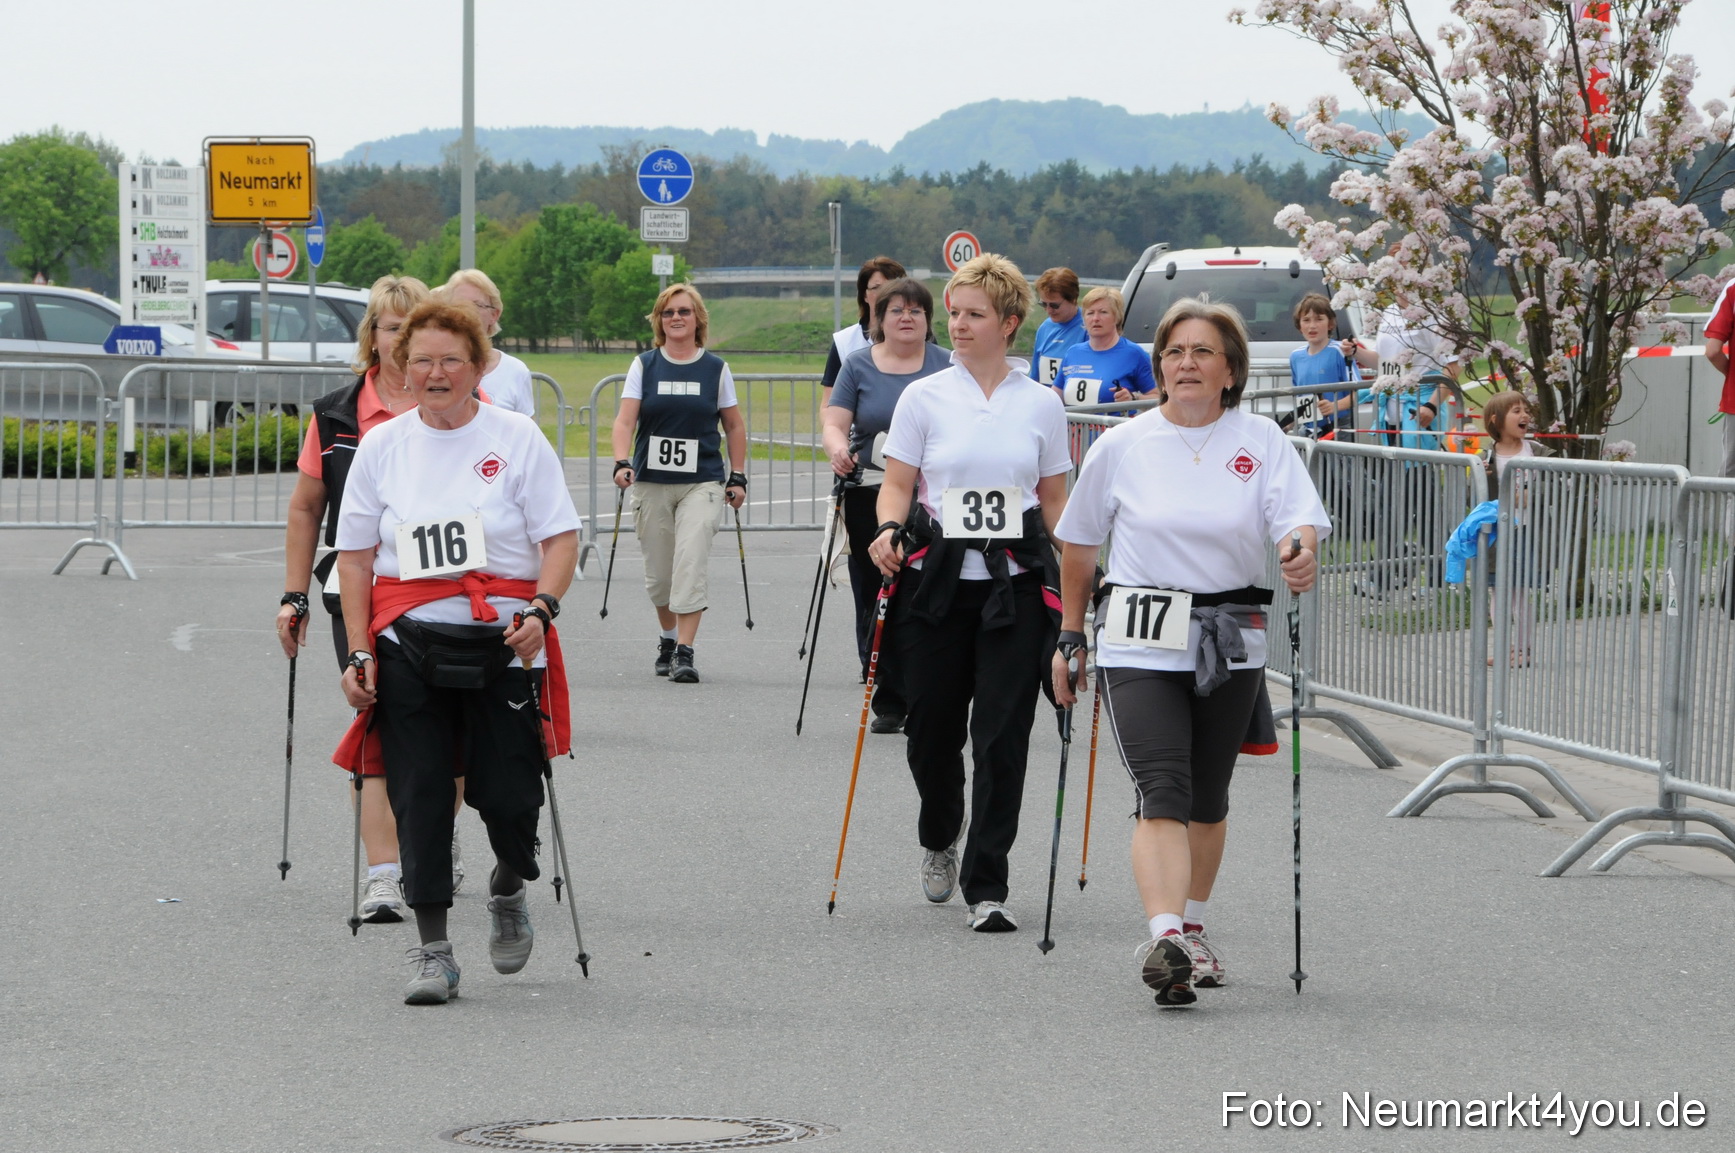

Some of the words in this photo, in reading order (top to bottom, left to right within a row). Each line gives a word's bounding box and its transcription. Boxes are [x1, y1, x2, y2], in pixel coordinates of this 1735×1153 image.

[246, 155, 275, 165] Nach
[219, 171, 302, 189] Neumarkt
[248, 196, 254, 206] 5
[262, 198, 277, 207] km
[646, 220, 683, 228] schaftlicher
[649, 211, 680, 219] Landwirt-
[139, 222, 156, 241] SHB
[646, 229, 670, 237] Verkehr
[672, 229, 684, 237] frei
[953, 244, 972, 262] 60
[139, 275, 166, 293] THULE
[116, 339, 156, 355] VOLVO
[1049, 359, 1058, 381] 5
[1076, 380, 1087, 402] 8
[658, 439, 687, 467] 95
[962, 490, 1006, 532] 33
[412, 520, 468, 570] 116
[1125, 593, 1172, 641] 117
